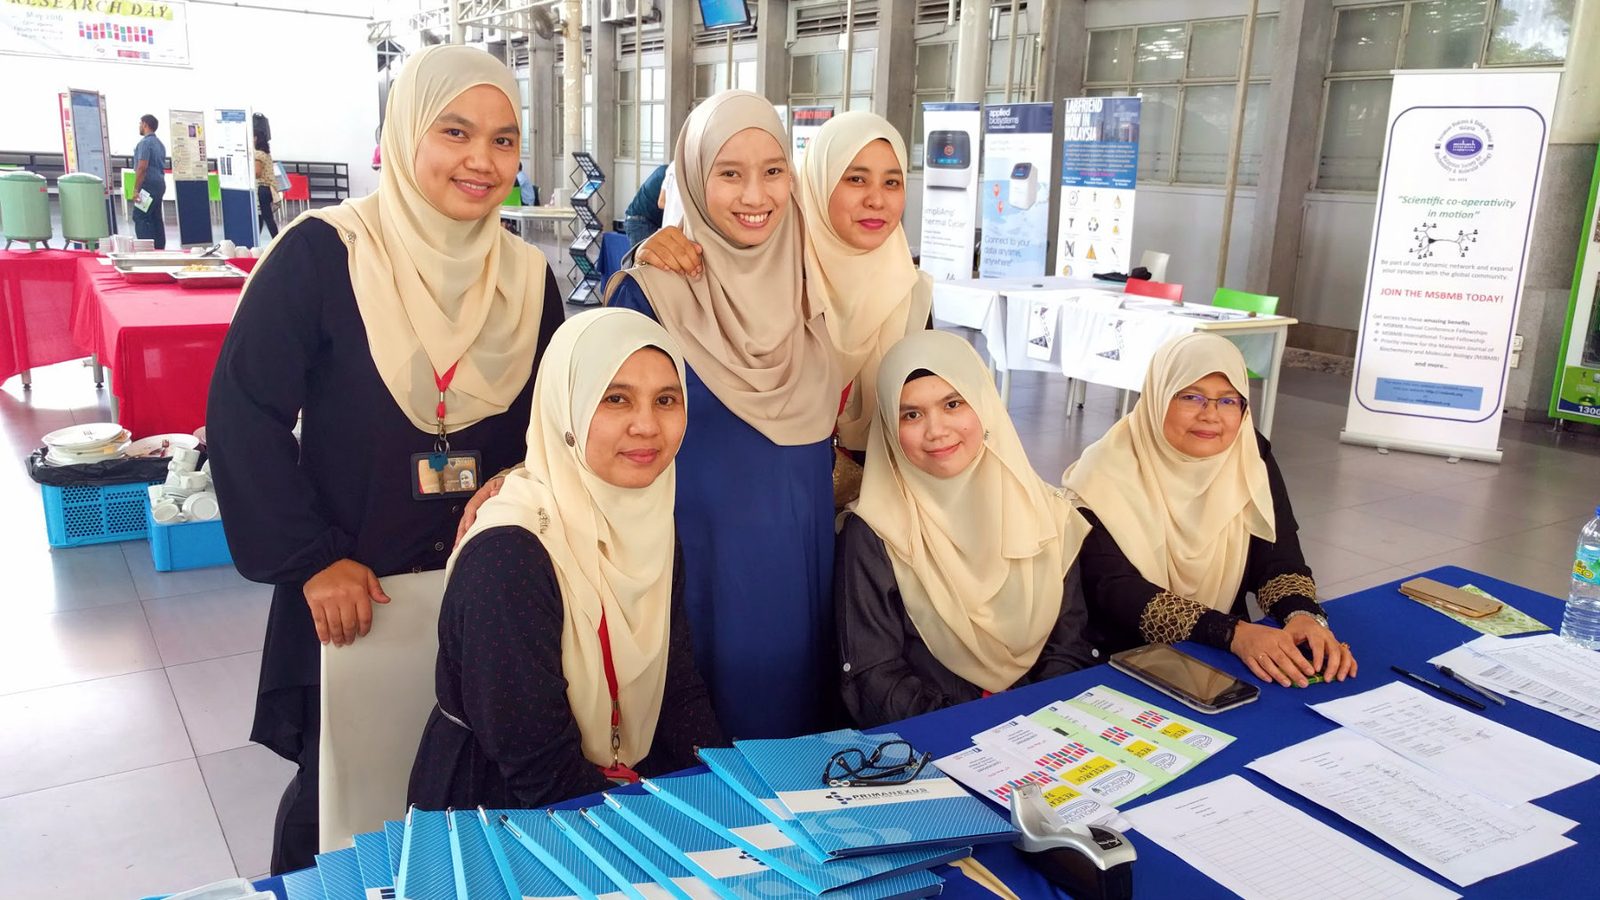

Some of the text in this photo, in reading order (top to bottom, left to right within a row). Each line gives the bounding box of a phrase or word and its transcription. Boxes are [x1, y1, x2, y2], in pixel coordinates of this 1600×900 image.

[131, 3, 169, 17] DAY
[1065, 99, 1104, 113] LABFRIEND
[989, 108, 1012, 118] applied
[1064, 127, 1098, 142] MALAYSIA
[1446, 198, 1516, 208] co-operativity
[1428, 210, 1436, 218] in
[984, 235, 1008, 244] Connect
[1451, 270, 1470, 278] global
[1380, 288, 1504, 303] JOIN THE MSBMB TODAY!
[1076, 763, 1110, 783] RESEARCH
[852, 787, 929, 800] PRIMANEXUS
